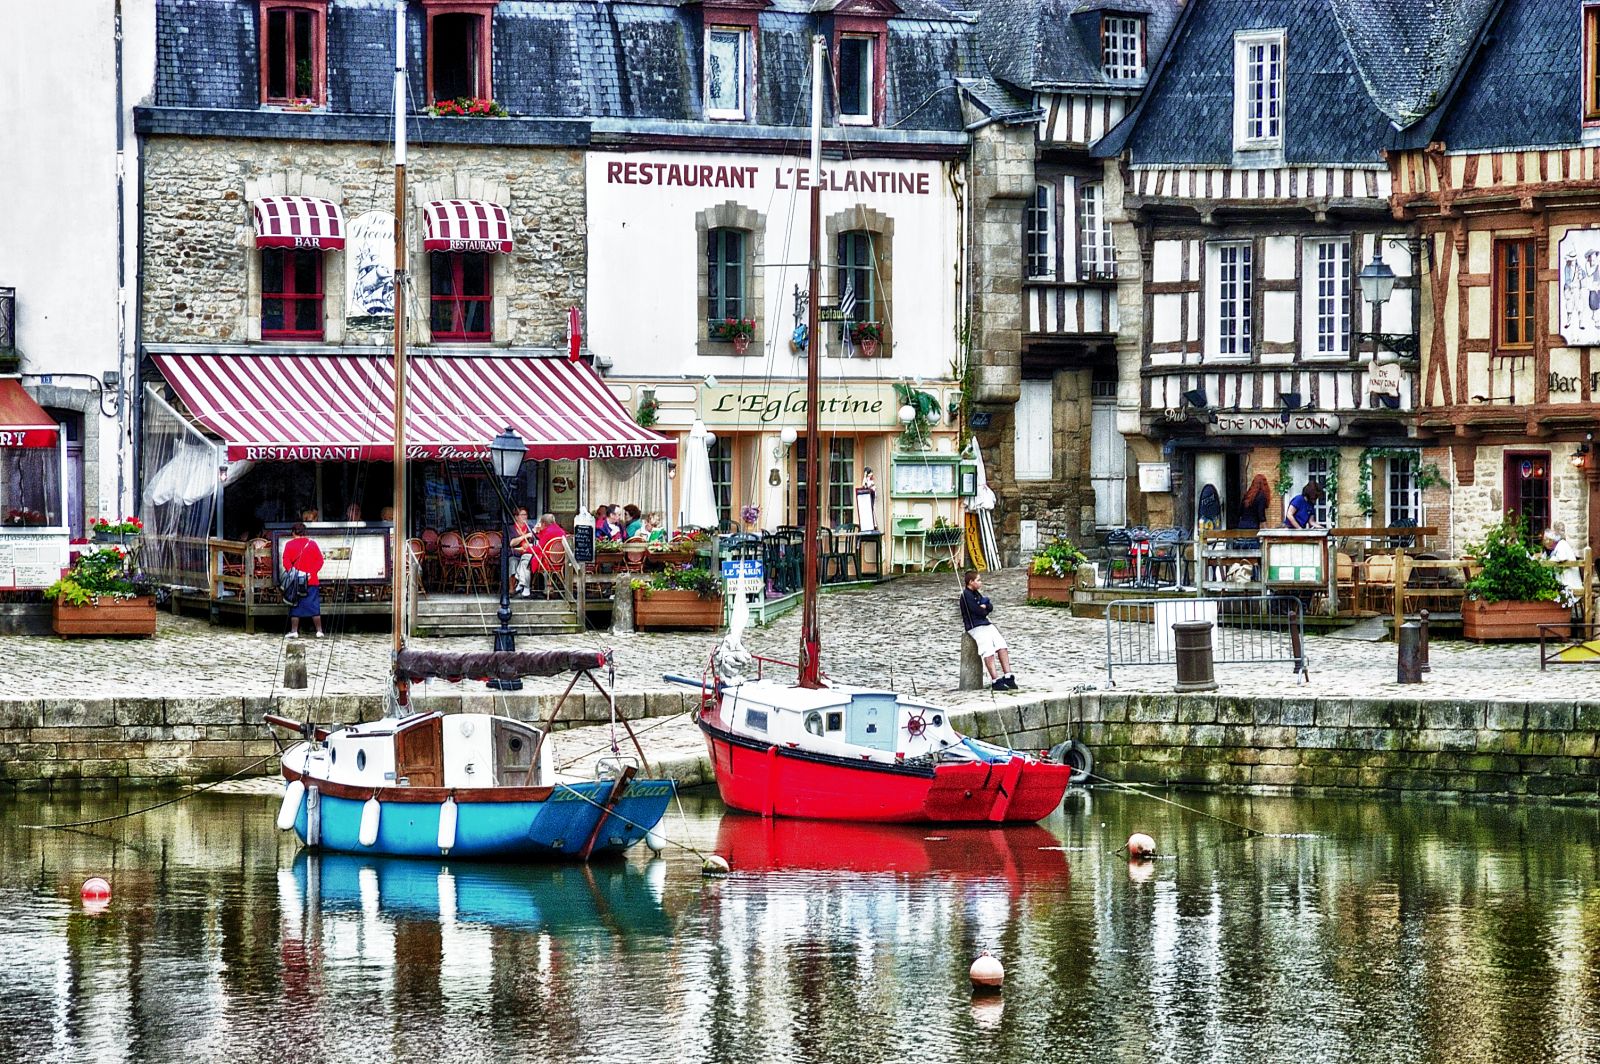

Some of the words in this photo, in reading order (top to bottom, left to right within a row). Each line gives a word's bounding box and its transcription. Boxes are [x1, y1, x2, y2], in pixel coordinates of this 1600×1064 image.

[607, 161, 759, 189] RESTAURANT
[775, 166, 930, 195] L'EGLANTINE
[294, 237, 320, 247] BAR
[449, 240, 503, 251] RESTAURANT
[1548, 371, 1582, 393] Bar
[711, 388, 884, 422] L'Eglantine
[1164, 408, 1188, 423] Pub
[1218, 418, 1245, 431] THE
[1295, 417, 1331, 430] TONK
[246, 446, 360, 461] RESTAURANT
[406, 445, 433, 459] La
[435, 445, 492, 460] Licorn
[588, 445, 614, 458] BAR
[617, 444, 660, 458] TABAC
